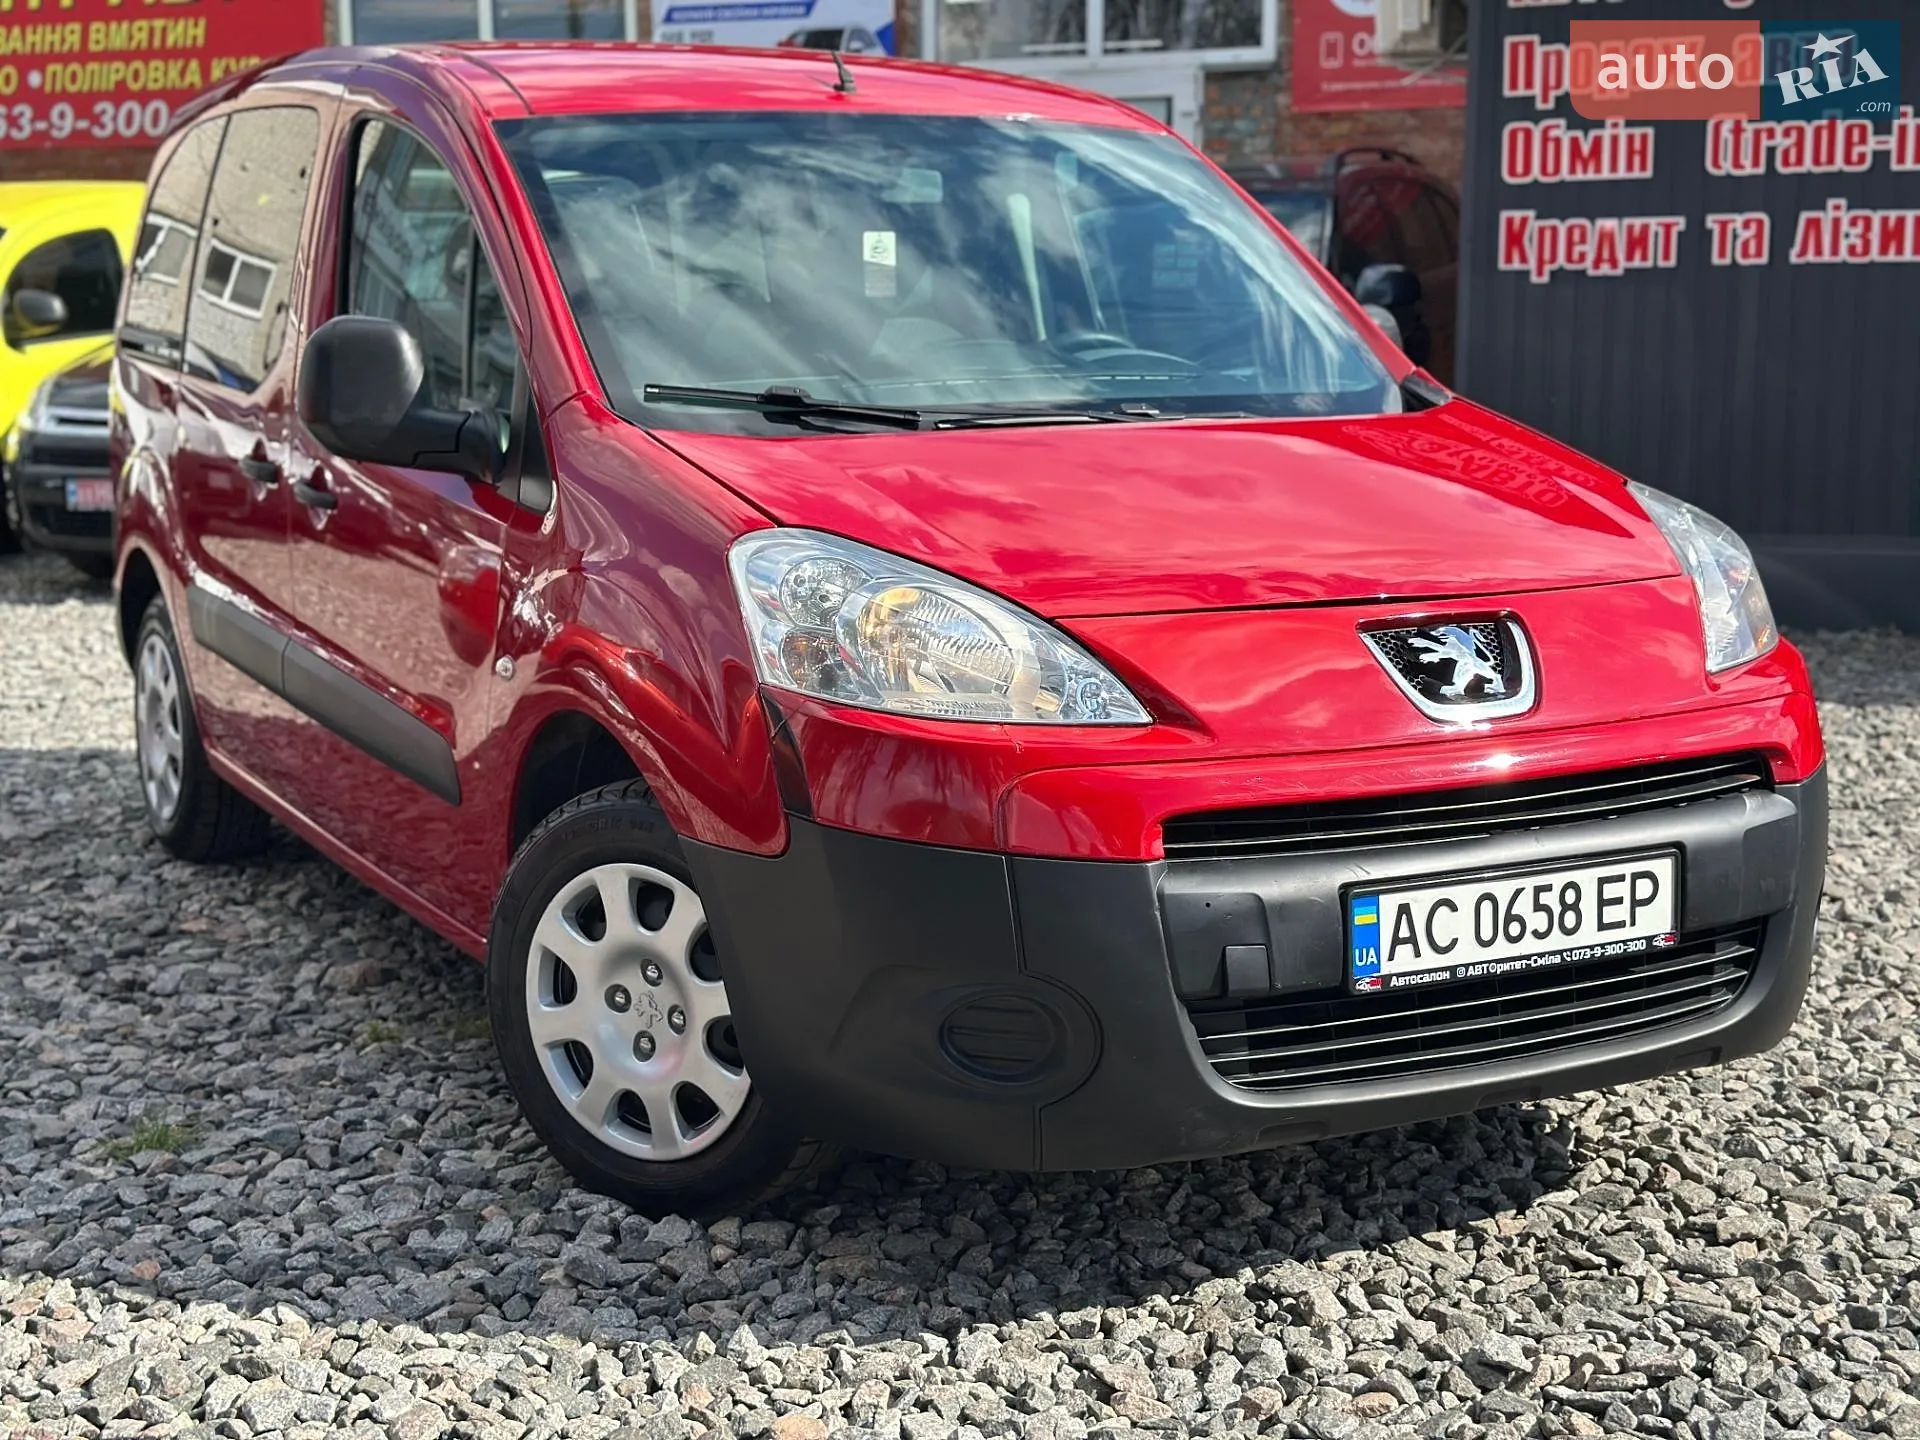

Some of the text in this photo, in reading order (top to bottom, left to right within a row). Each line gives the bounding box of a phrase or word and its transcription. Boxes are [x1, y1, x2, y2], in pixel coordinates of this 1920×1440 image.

[88, 17, 206, 52] ВМЯТИН
[44, 58, 202, 94] ПОЛІРОВКА
[1501, 118, 1655, 184] Обмін
[1498, 209, 1686, 283] Кредит
[1706, 212, 1770, 265] та
[1387, 870, 1660, 961] AC 0658 EP
[1355, 947, 1378, 966] UA
[1390, 970, 1450, 987] Автосалон
[1571, 939, 1647, 961] 073-9-300-300
